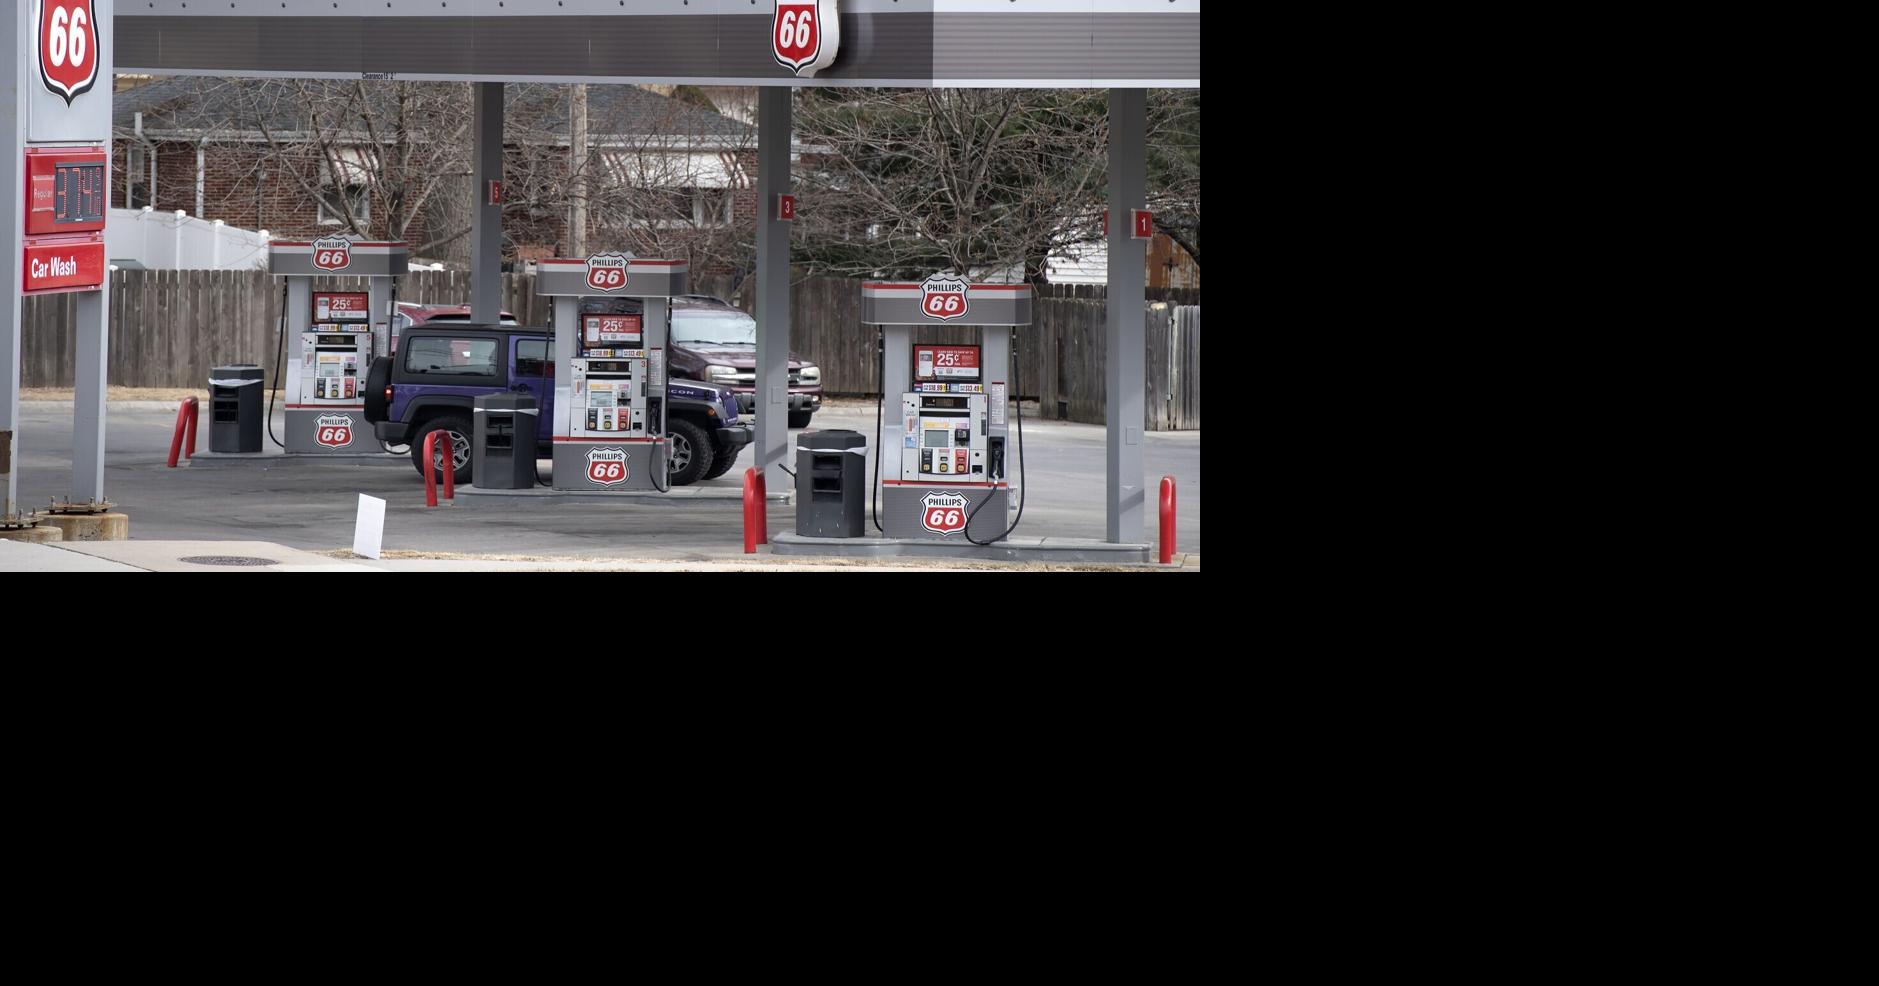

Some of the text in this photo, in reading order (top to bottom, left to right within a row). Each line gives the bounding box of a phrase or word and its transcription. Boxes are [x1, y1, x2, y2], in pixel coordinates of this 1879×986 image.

[780, 10, 812, 48] 66
[49, 6, 87, 67] 66
[785, 201, 790, 213] 3
[1141, 217, 1146, 231] 1
[319, 251, 344, 265] 66
[31, 256, 77, 279] Car Wash
[593, 270, 620, 284] 66
[927, 284, 962, 292] PHILLIPS
[930, 296, 960, 311] 66
[322, 429, 347, 441] 66
[593, 463, 620, 478] 66
[928, 498, 962, 506] PHILLIPS
[930, 510, 960, 526] 66
